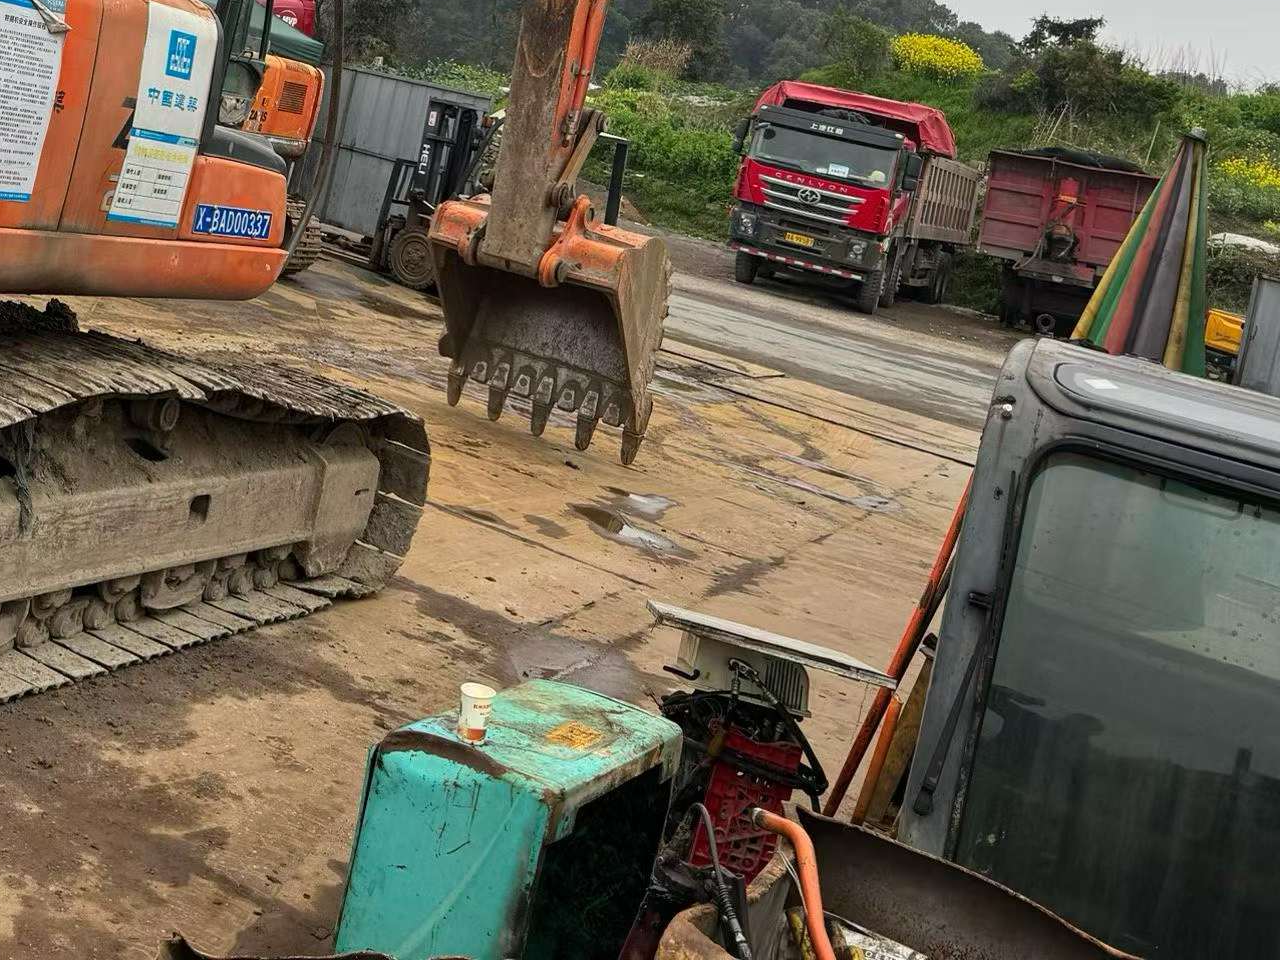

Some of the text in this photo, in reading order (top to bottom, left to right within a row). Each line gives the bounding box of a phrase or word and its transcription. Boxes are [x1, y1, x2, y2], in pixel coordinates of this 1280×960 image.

[249, 109, 268, 122] ZAIS
[418, 143, 431, 175] HELI
[195, 207, 271, 236] X-BAD00337
